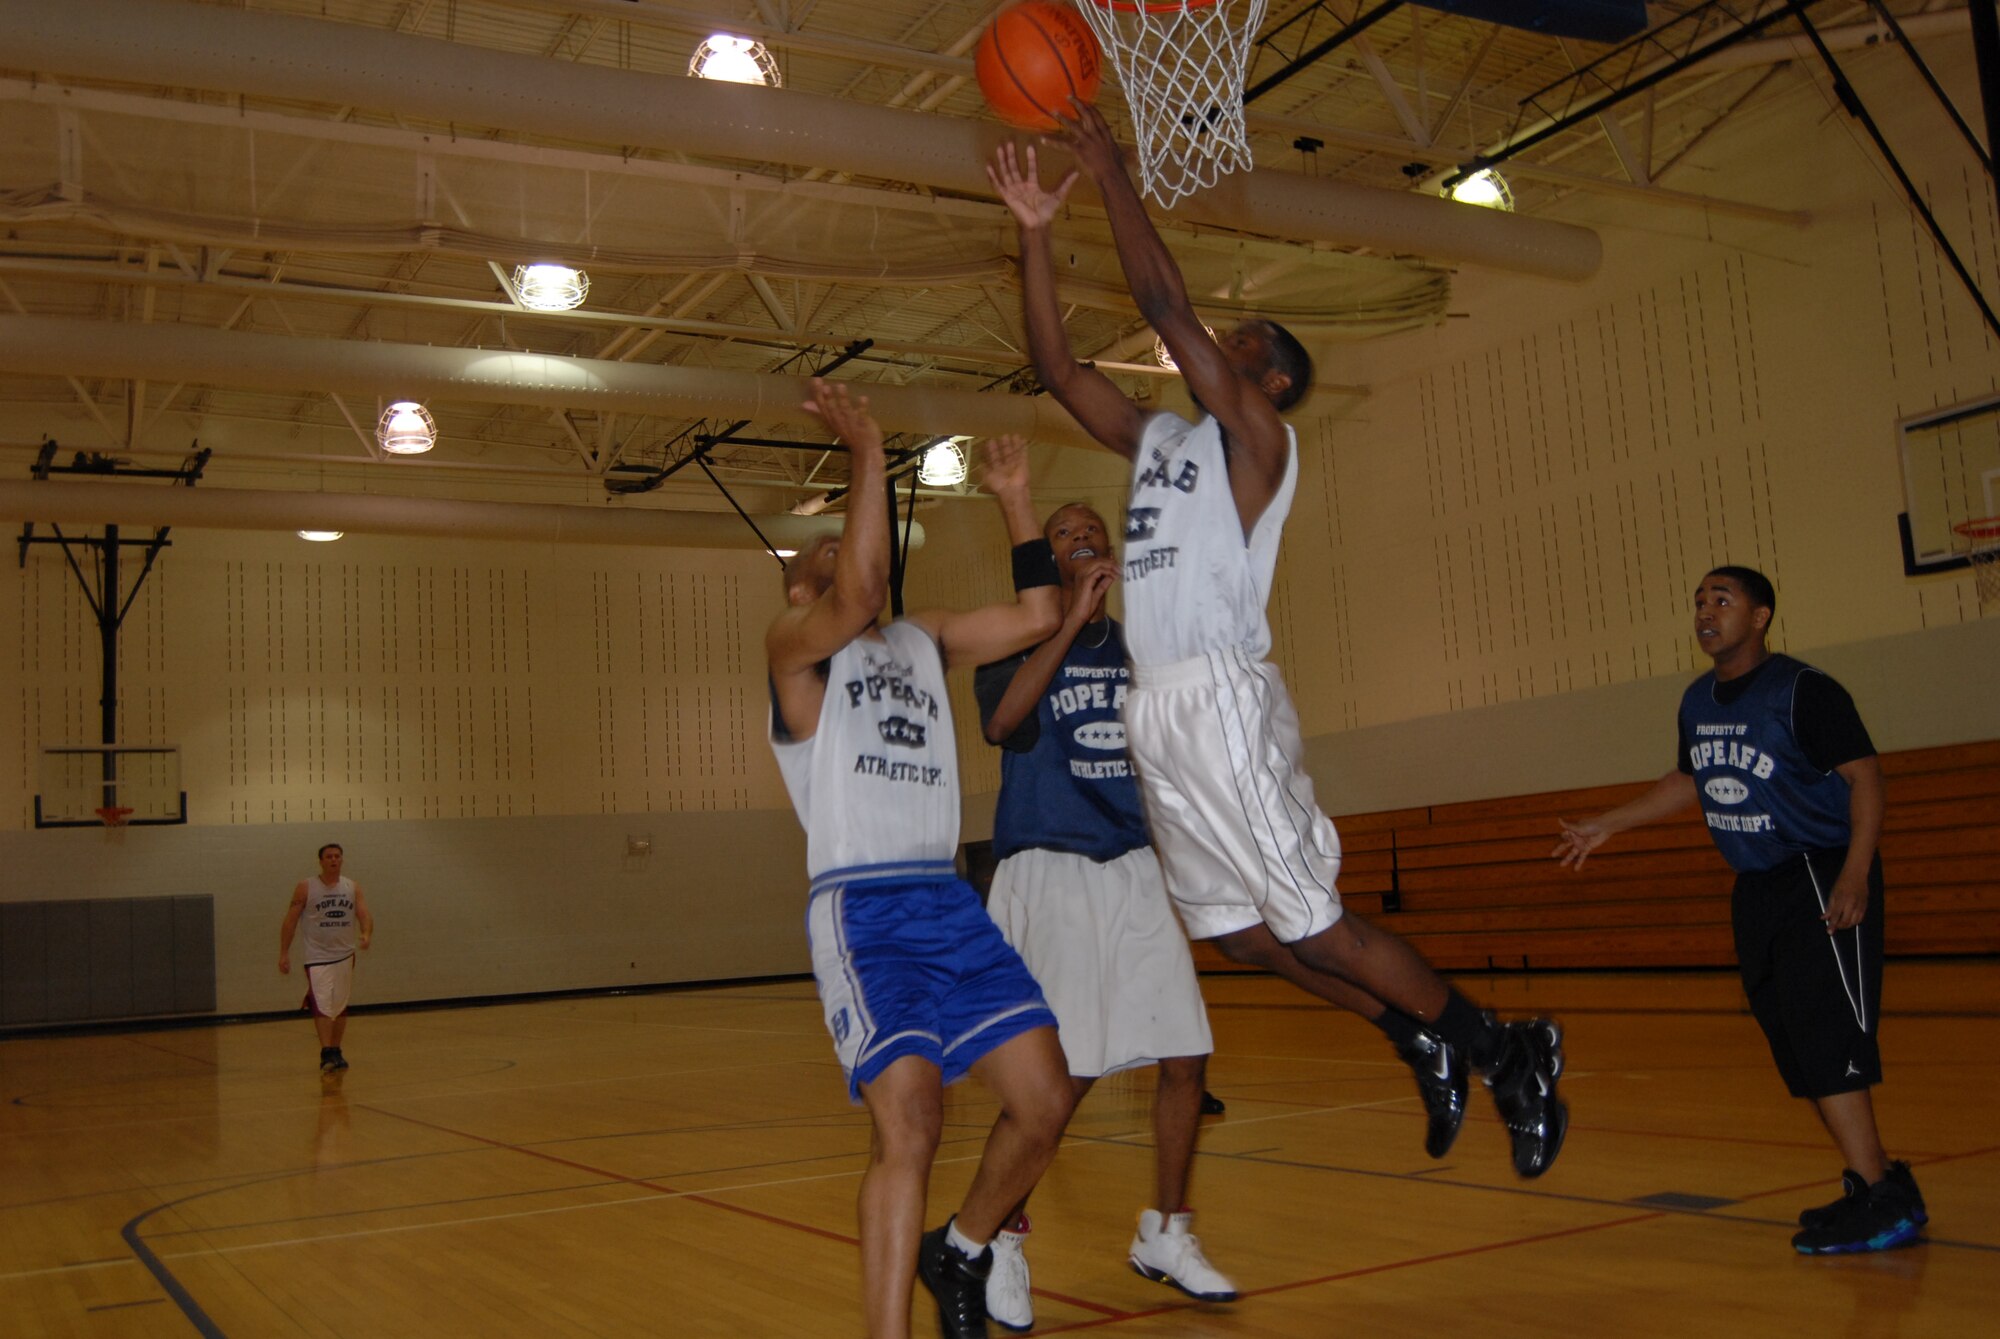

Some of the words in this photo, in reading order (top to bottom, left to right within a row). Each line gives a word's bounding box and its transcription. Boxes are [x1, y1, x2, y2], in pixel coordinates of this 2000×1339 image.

[1064, 667, 1117, 678] PROPERTY
[1050, 683, 1108, 721] POPE
[1696, 725, 1734, 735] PROPERTY
[1736, 725, 1747, 735] OF
[854, 755, 919, 781] ATHETIC
[1690, 740, 1726, 770] OPE
[1728, 741, 1774, 779] AFB
[1070, 760, 1128, 779] ATHLETIC
[316, 899, 336, 911] POPE
